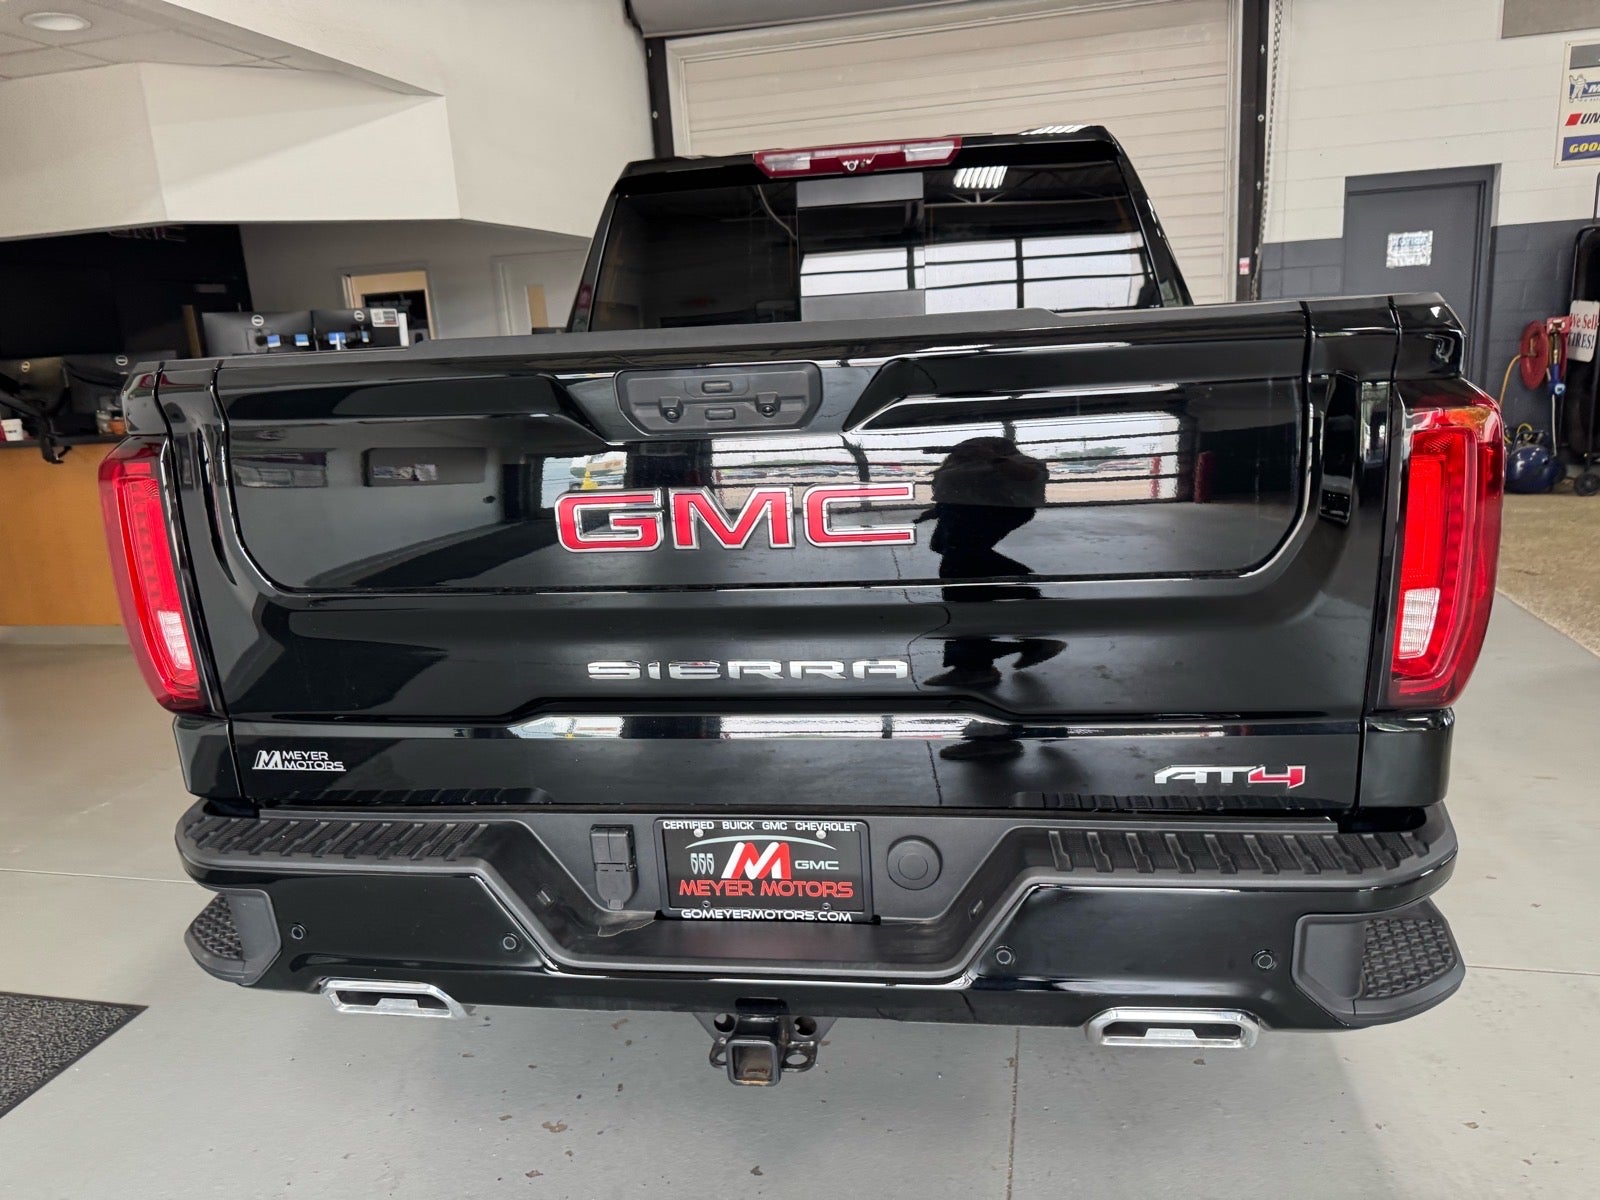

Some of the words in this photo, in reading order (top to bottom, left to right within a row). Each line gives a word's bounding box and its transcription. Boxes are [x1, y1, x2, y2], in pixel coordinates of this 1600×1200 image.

[555, 481, 917, 552] GMC
[587, 660, 908, 680] SIERRA
[282, 751, 328, 760] MEYER
[284, 761, 344, 770] MOTORS
[1154, 764, 1306, 789] AT4
[663, 821, 714, 830] CERTIFIED
[722, 821, 754, 830] BUICK
[762, 822, 787, 831] GMC
[795, 822, 857, 832] CHEVROLET
[794, 860, 839, 870] GMC
[679, 880, 755, 896] MEYER
[760, 881, 853, 898] MOTORS
[681, 909, 852, 922] GOMEYERMOTORS.COM
